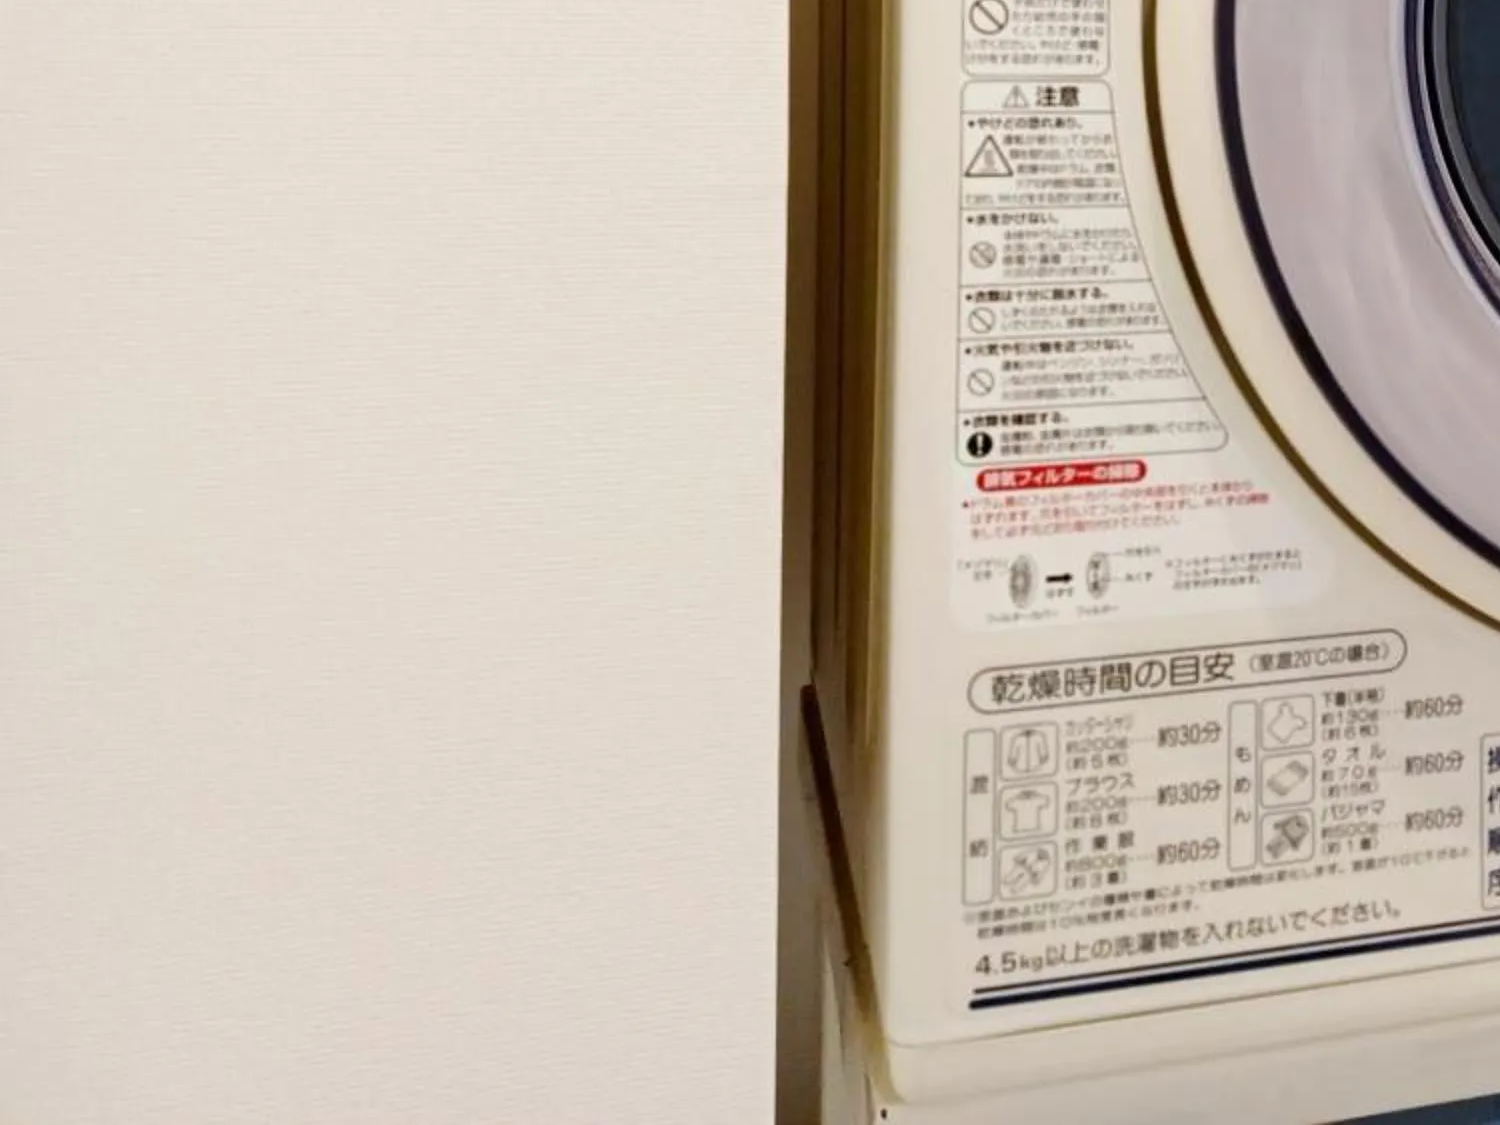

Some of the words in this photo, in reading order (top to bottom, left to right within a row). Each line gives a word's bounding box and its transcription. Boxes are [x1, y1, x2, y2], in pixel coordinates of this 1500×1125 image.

[1035, 85, 1080, 107] 注意
[991, 651, 1236, 704] 乾燥時間の目安
[1404, 693, 1464, 720] 約60分
[1157, 720, 1222, 748] 約30分
[1404, 749, 1465, 776] 約60分
[1157, 779, 1222, 807] 約30分
[1404, 804, 1464, 832] 約60分
[1156, 837, 1222, 866] 約60分
